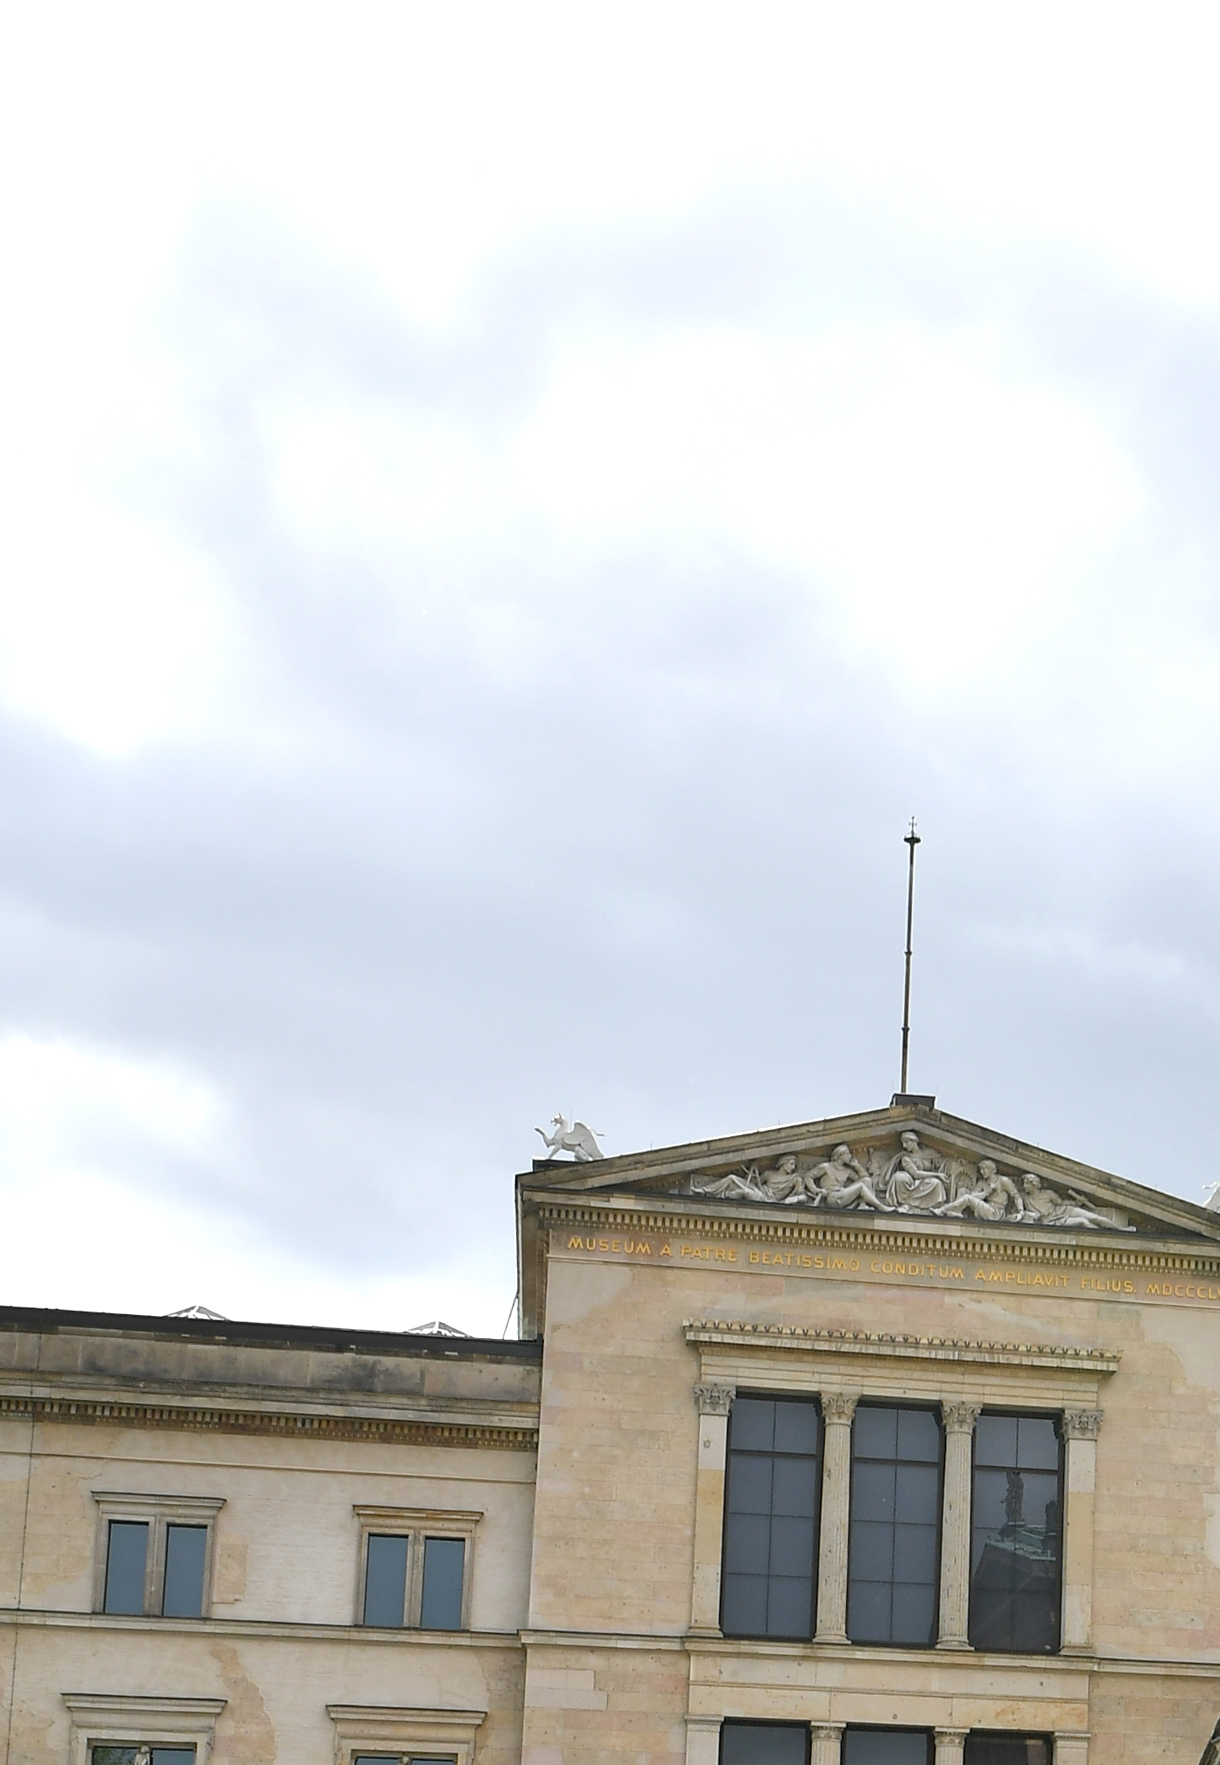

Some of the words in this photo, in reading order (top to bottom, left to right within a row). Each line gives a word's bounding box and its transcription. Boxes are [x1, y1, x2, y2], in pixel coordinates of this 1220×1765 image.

[568, 1236, 650, 1255] MUSEUM
[660, 1245, 672, 1257] A
[681, 1245, 737, 1262] PATRE
[749, 1252, 860, 1272] BEATISSIMO
[871, 1260, 964, 1280] CONDITUM
[975, 1271, 1069, 1289] AMPLIAVIT
[1080, 1276, 1137, 1294] FILIUS.
